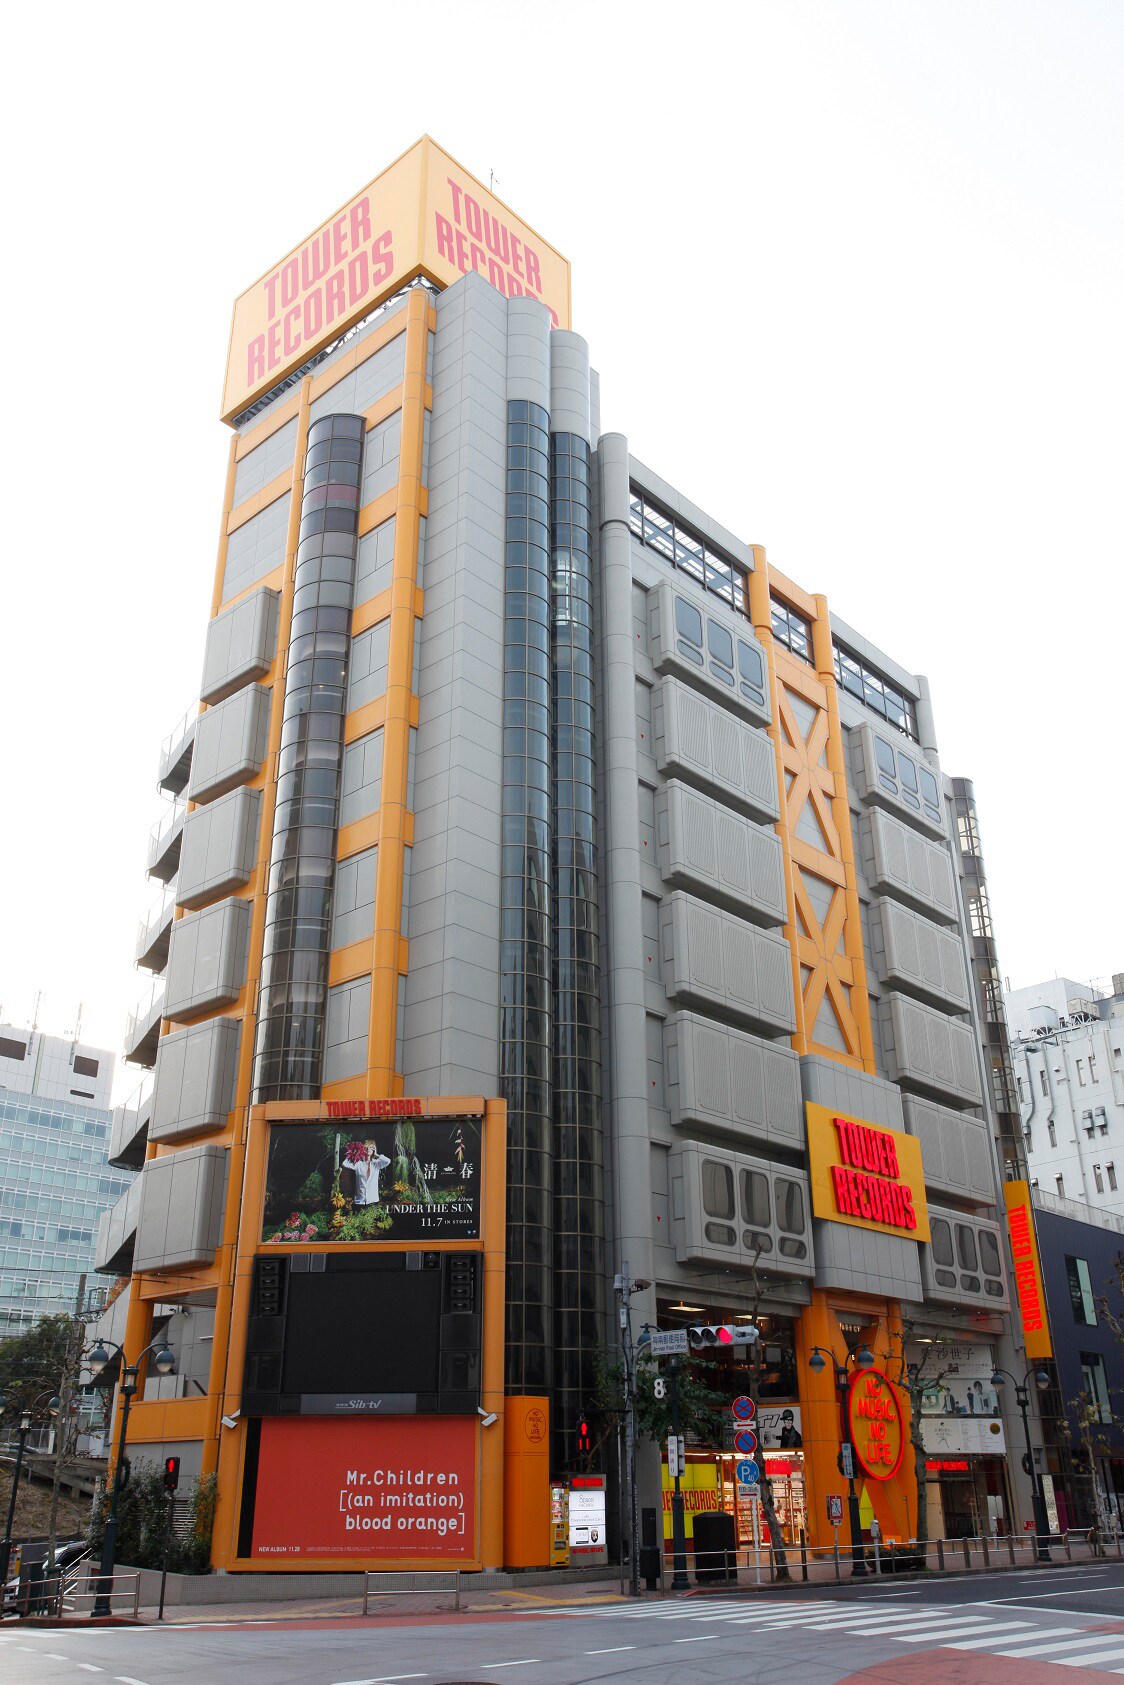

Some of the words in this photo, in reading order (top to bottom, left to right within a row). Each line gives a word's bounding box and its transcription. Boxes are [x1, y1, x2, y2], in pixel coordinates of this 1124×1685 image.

[447, 176, 542, 295] TOWER
[263, 196, 371, 322] TOWER
[435, 210, 559, 330] RECOR
[247, 229, 394, 388] RECORDS
[326, 1100, 366, 1118] TOWER
[369, 1098, 422, 1116] RECORDS
[832, 1117, 900, 1179] TOWER
[386, 1204, 424, 1214] UNDER
[425, 1203, 449, 1213] THE
[451, 1203, 473, 1213] SUN
[830, 1165, 917, 1230] RECORDS
[421, 1217, 443, 1227] 11.7
[1008, 1204, 1032, 1258] TOWER
[1015, 1259, 1043, 1332] RECORDS
[654, 1379, 665, 1398] 8
[866, 1379, 882, 1397] NO
[870, 1422, 887, 1441] NO
[346, 1470, 458, 1485] Mr.Children
[742, 1466, 750, 1481] P
[339, 1490, 373, 1511] [(an
[380, 1492, 464, 1509] imitation)
[346, 1514, 391, 1530] blood
[397, 1512, 465, 1536] orange]
